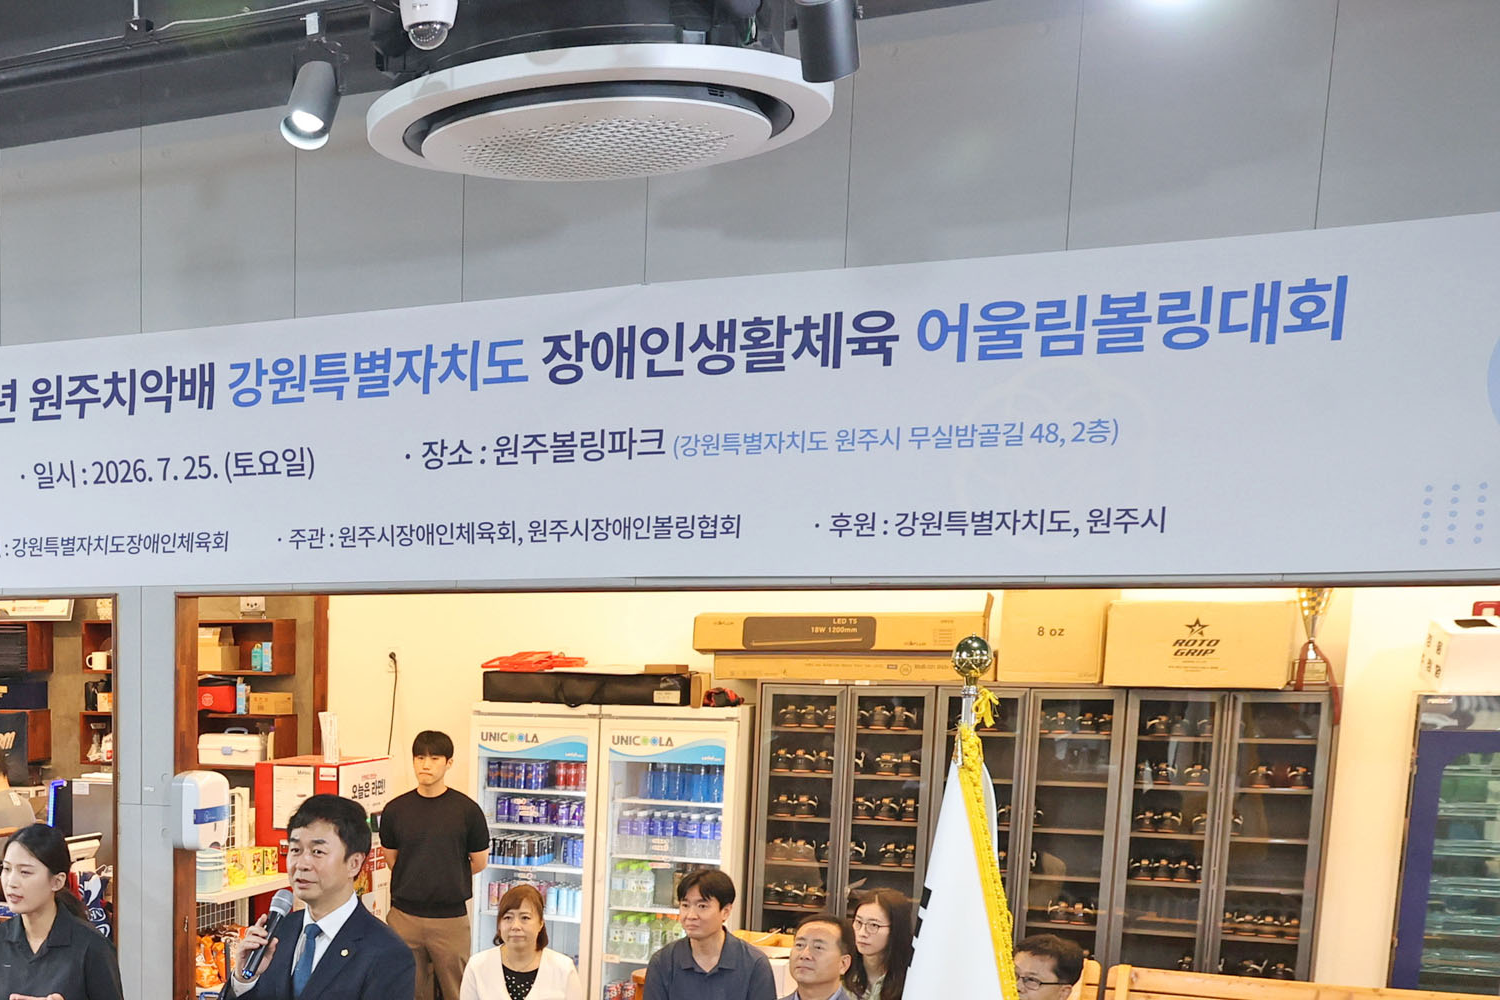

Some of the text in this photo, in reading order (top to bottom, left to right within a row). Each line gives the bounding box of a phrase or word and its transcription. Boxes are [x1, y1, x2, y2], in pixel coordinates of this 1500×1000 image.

[29, 361, 215, 422] 원주치악배
[228, 338, 529, 408] 강원특별자치도
[541, 310, 900, 386] 장애인생활체육
[917, 274, 1349, 363] 어울림볼링대회
[421, 438, 474, 471] 장소
[492, 427, 666, 466] 원주볼링파크
[673, 430, 828, 460] (강원특별자치도
[834, 426, 901, 453] 원주시
[907, 421, 1024, 450] 무실밤골길
[1029, 422, 1066, 448] 48,
[1070, 418, 1119, 446] 2층)
[33, 459, 76, 490] 일시
[91, 458, 153, 485] 2026.
[156, 457, 179, 482] 7.
[182, 455, 219, 480] 25.
[224, 446, 315, 484] (토요일)
[288, 527, 326, 551] 주관
[338, 520, 524, 549] 원주시장애인체육회,
[527, 513, 741, 543] 원주시장애인볼링협회
[829, 511, 876, 539] 후원
[894, 508, 1080, 538] 강원특별자치도,
[1086, 505, 1167, 535] 원주시
[11, 530, 229, 558] 강원특별자치도장애인체육회
[1037, 626, 1065, 637] 8 oz
[1171, 638, 1221, 648] ROTO
[1173, 648, 1216, 657] GRIP
[351, 778, 386, 800] 오늘은 라면!
